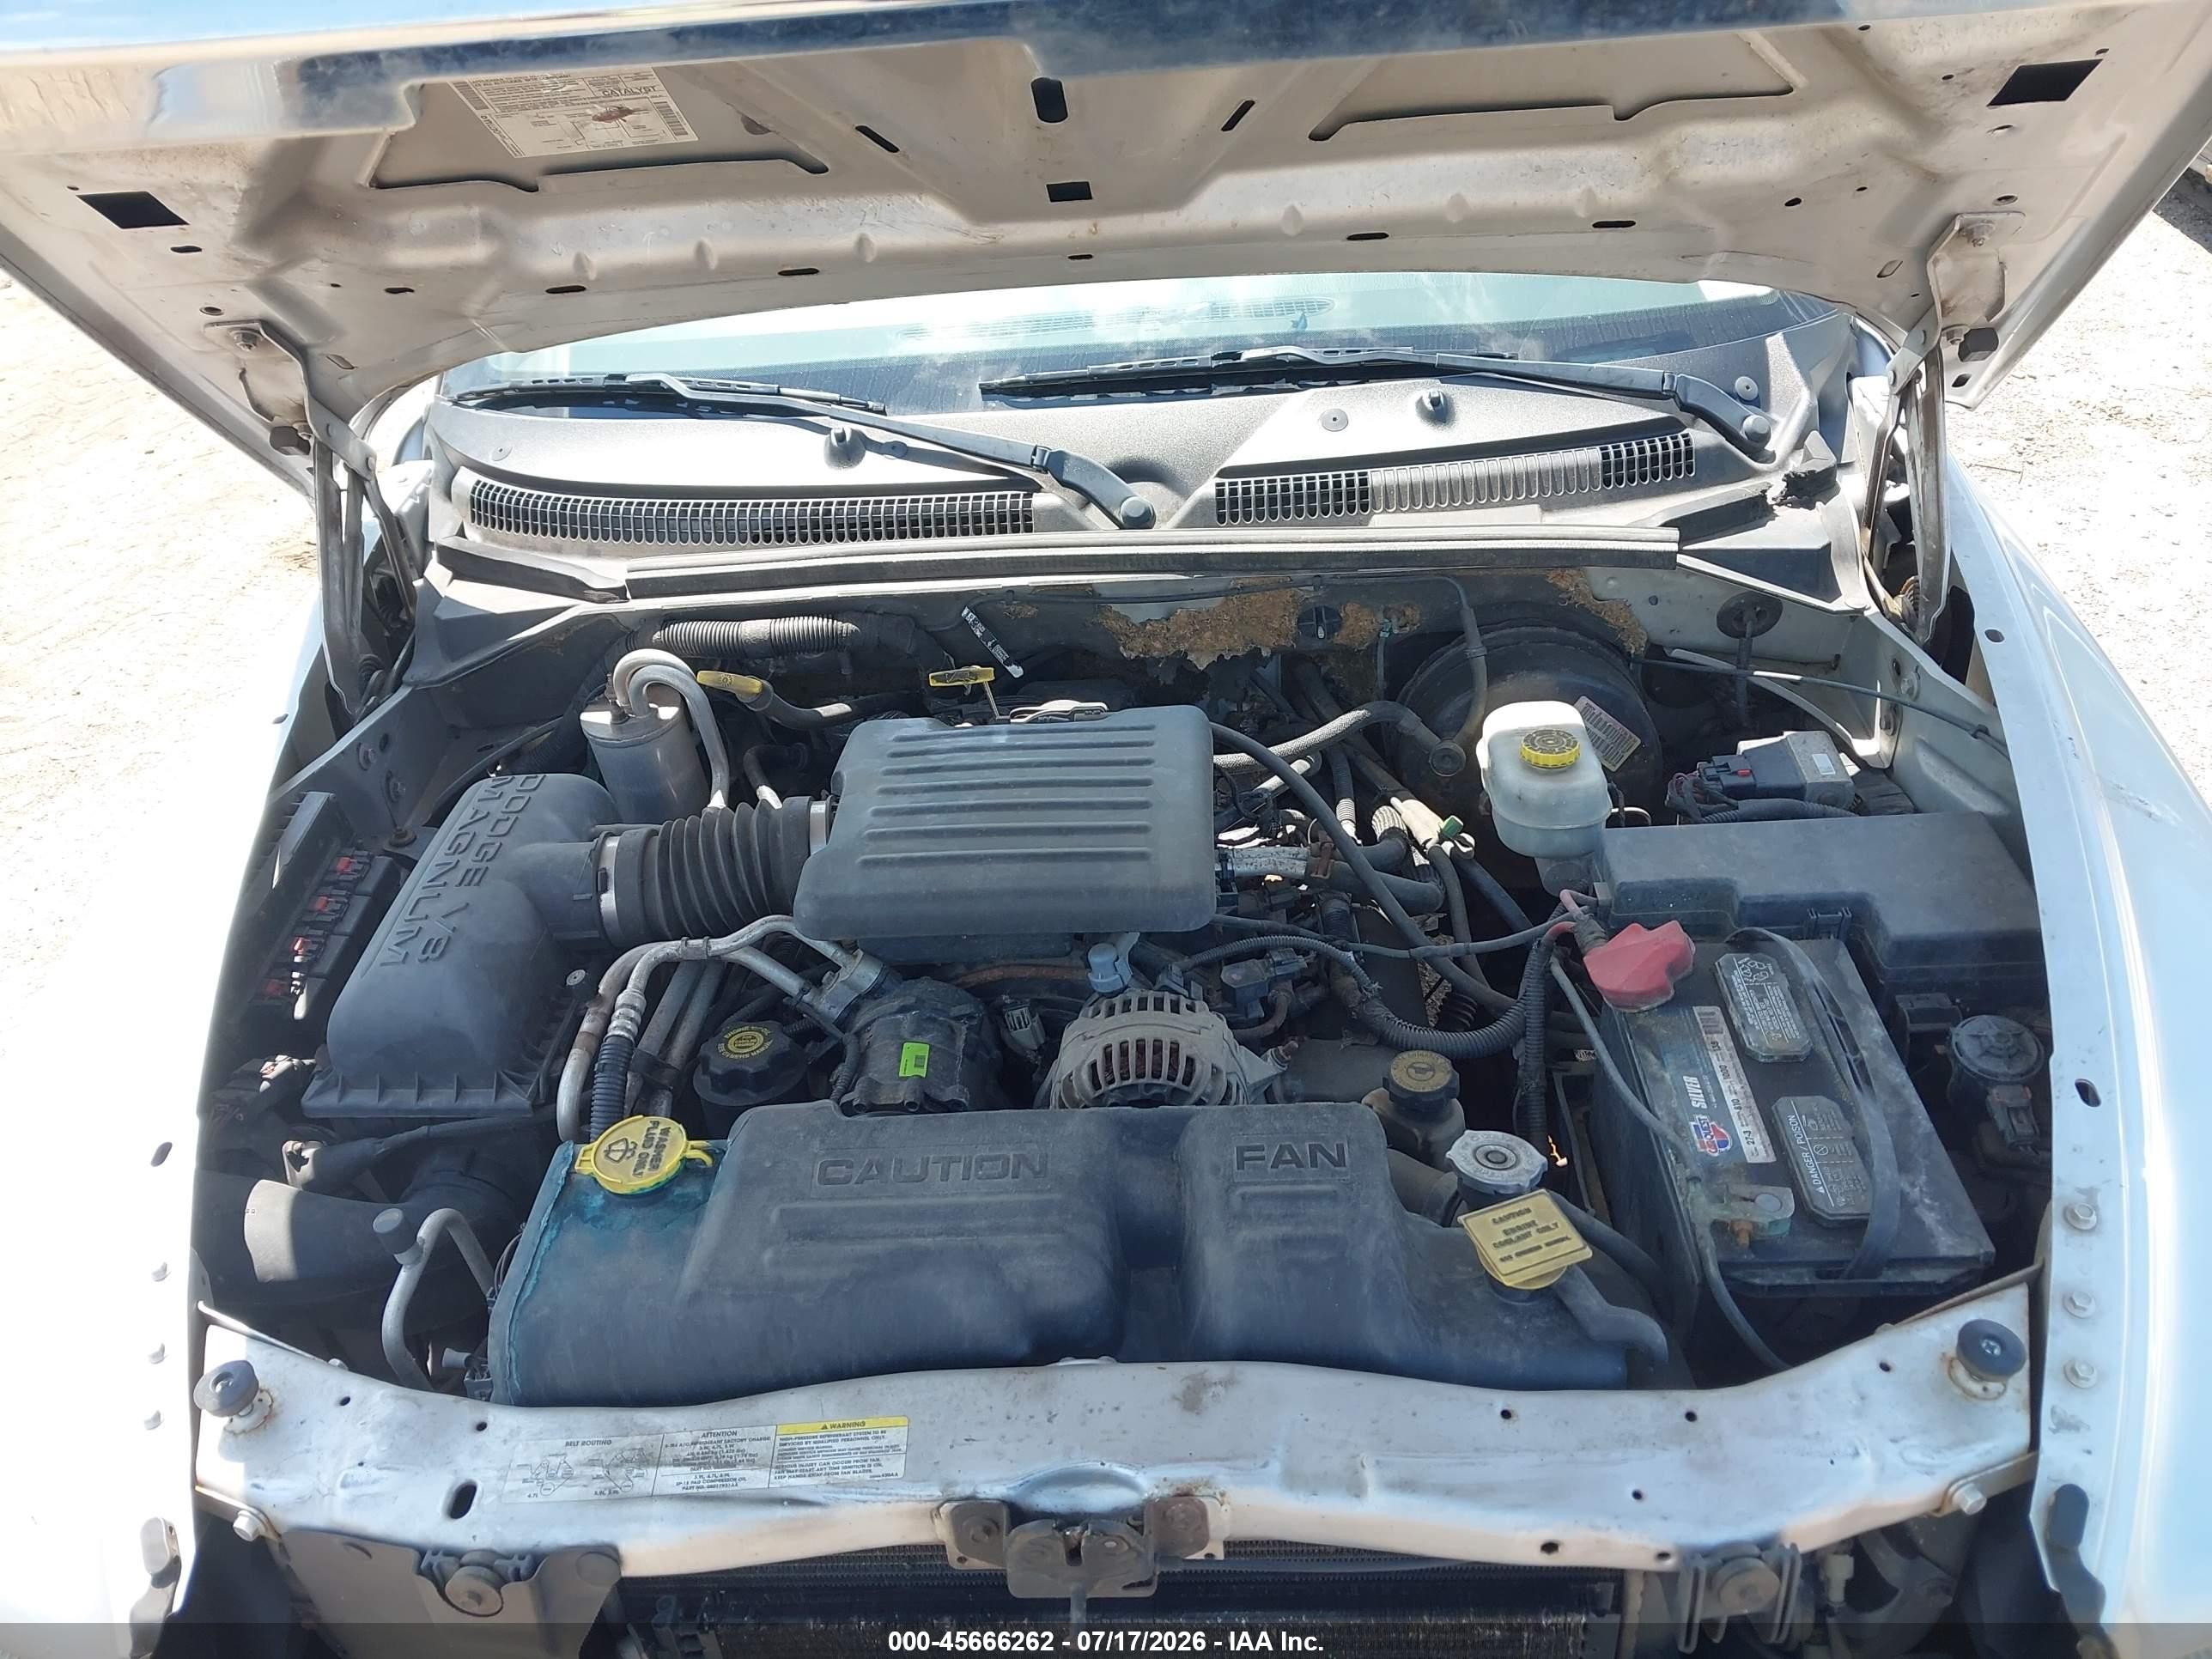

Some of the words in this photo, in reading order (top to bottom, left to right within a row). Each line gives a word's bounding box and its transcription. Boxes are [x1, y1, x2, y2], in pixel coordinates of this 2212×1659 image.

[602, 85, 657, 96] CATALYST
[454, 774, 547, 888] DODGE
[380, 775, 514, 967] MAGNUM
[417, 902, 470, 963] V8
[1683, 1075, 1707, 1109] SILVER
[641, 1120, 660, 1149] FLUID
[1787, 1115, 1806, 1146] POISON
[647, 1127, 671, 1171] WASHER
[1234, 1141, 1348, 1171] FAN
[816, 1152, 1048, 1187] CAUTION
[1802, 1152, 1821, 1185] DANGER
[702, 1430, 737, 1438] ATTENTION
[830, 1420, 866, 1429] WARNING
